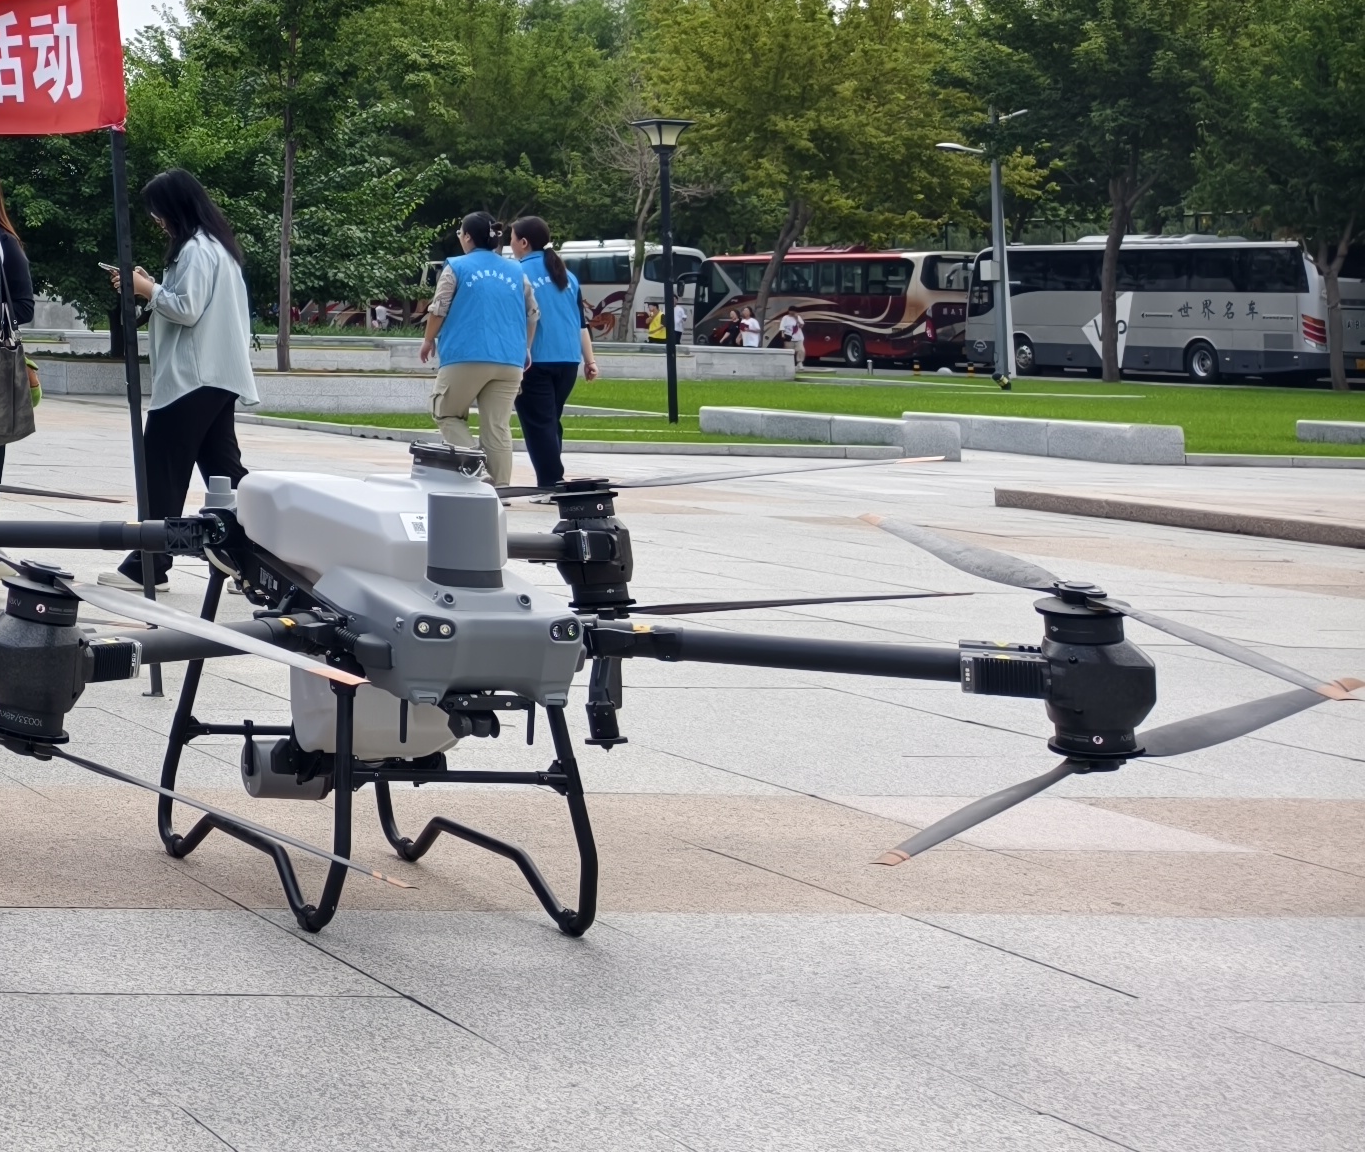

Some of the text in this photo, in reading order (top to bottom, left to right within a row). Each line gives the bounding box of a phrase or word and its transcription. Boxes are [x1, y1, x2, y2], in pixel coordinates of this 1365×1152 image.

[1177, 299, 1259, 321] 世界名车
[1093, 319, 1128, 342] VP
